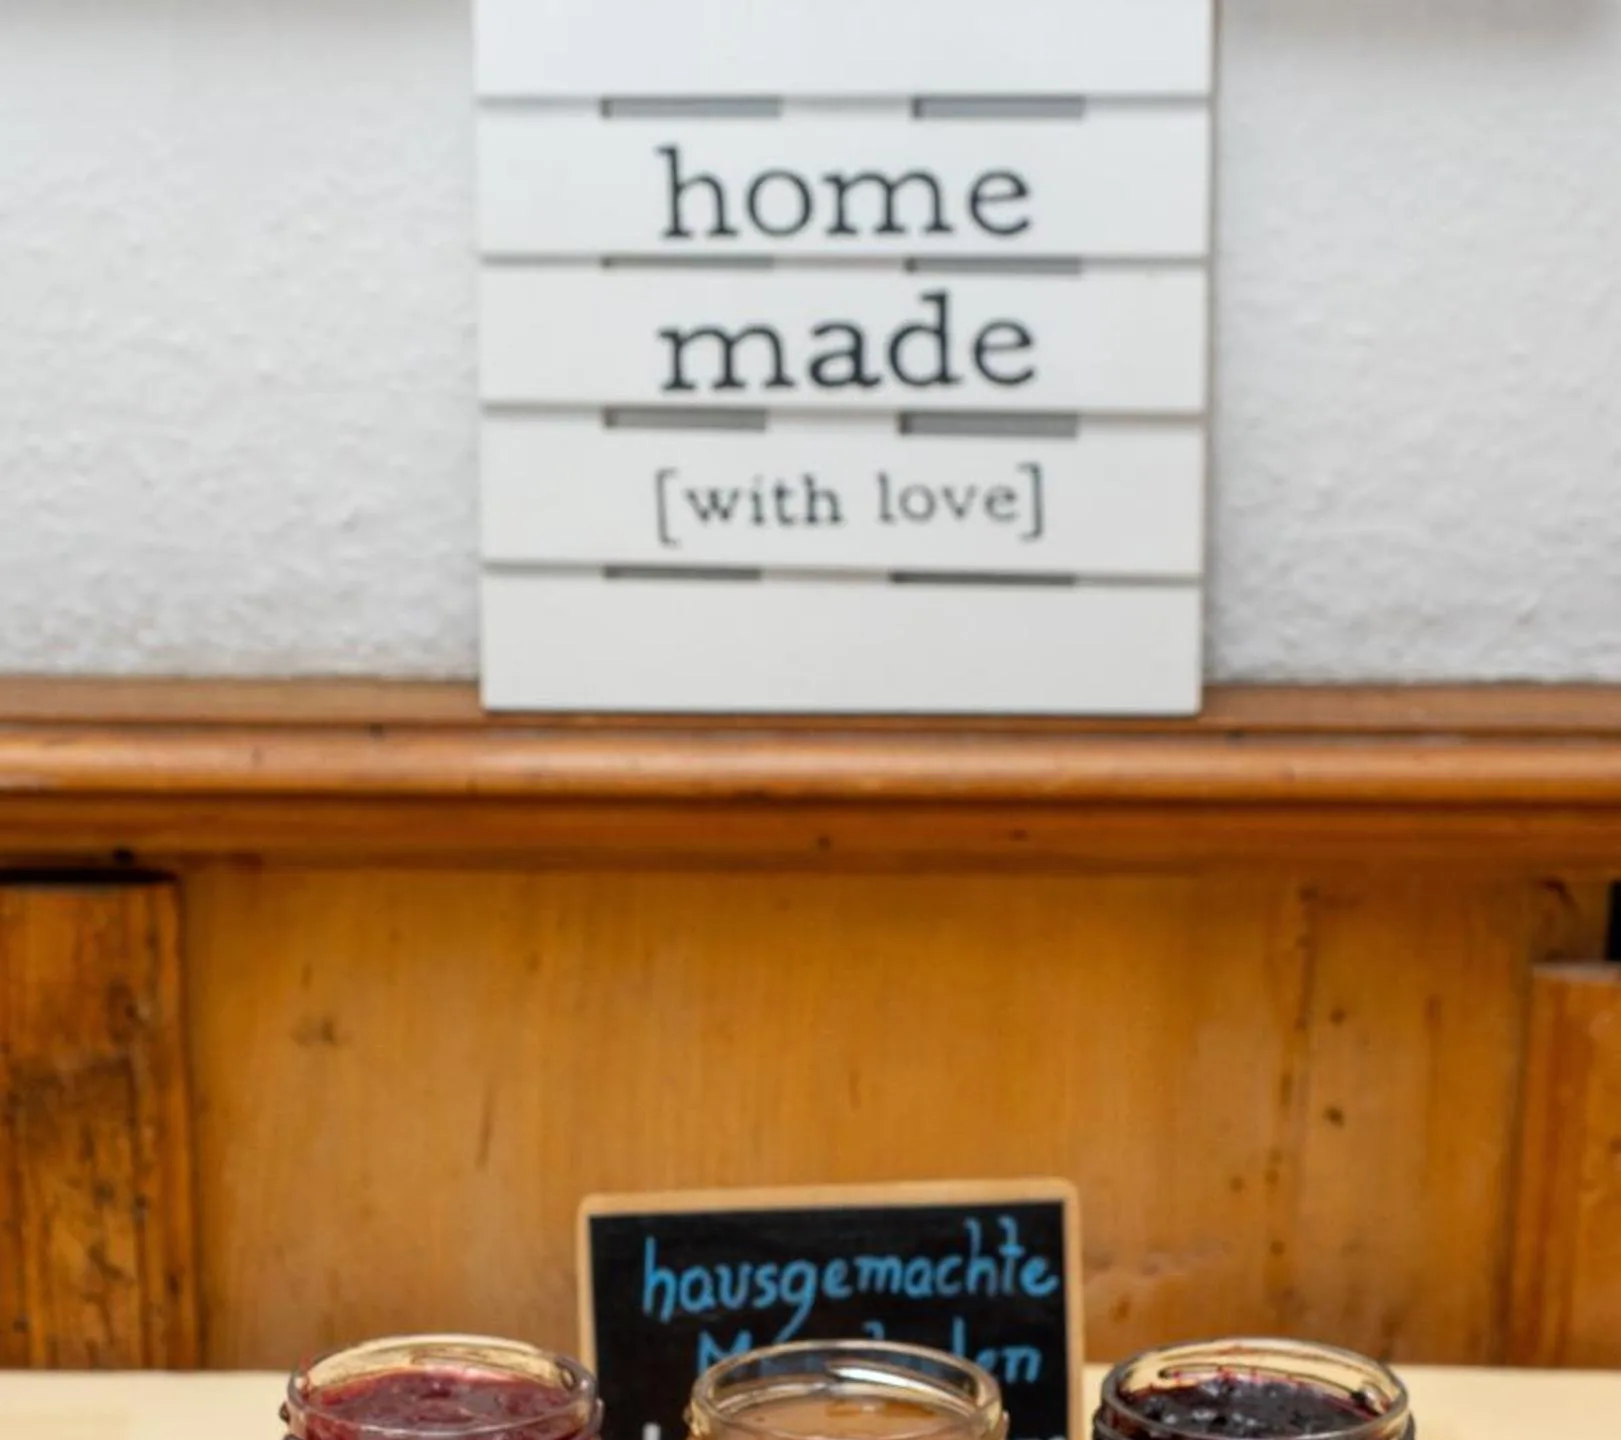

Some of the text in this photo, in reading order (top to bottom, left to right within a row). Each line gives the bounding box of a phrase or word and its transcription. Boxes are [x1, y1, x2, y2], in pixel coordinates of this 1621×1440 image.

[656, 144, 1031, 239] home
[657, 290, 1037, 392] made
[655, 462, 1044, 547] [with love]
[642, 1215, 1060, 1344] hausgemachte
